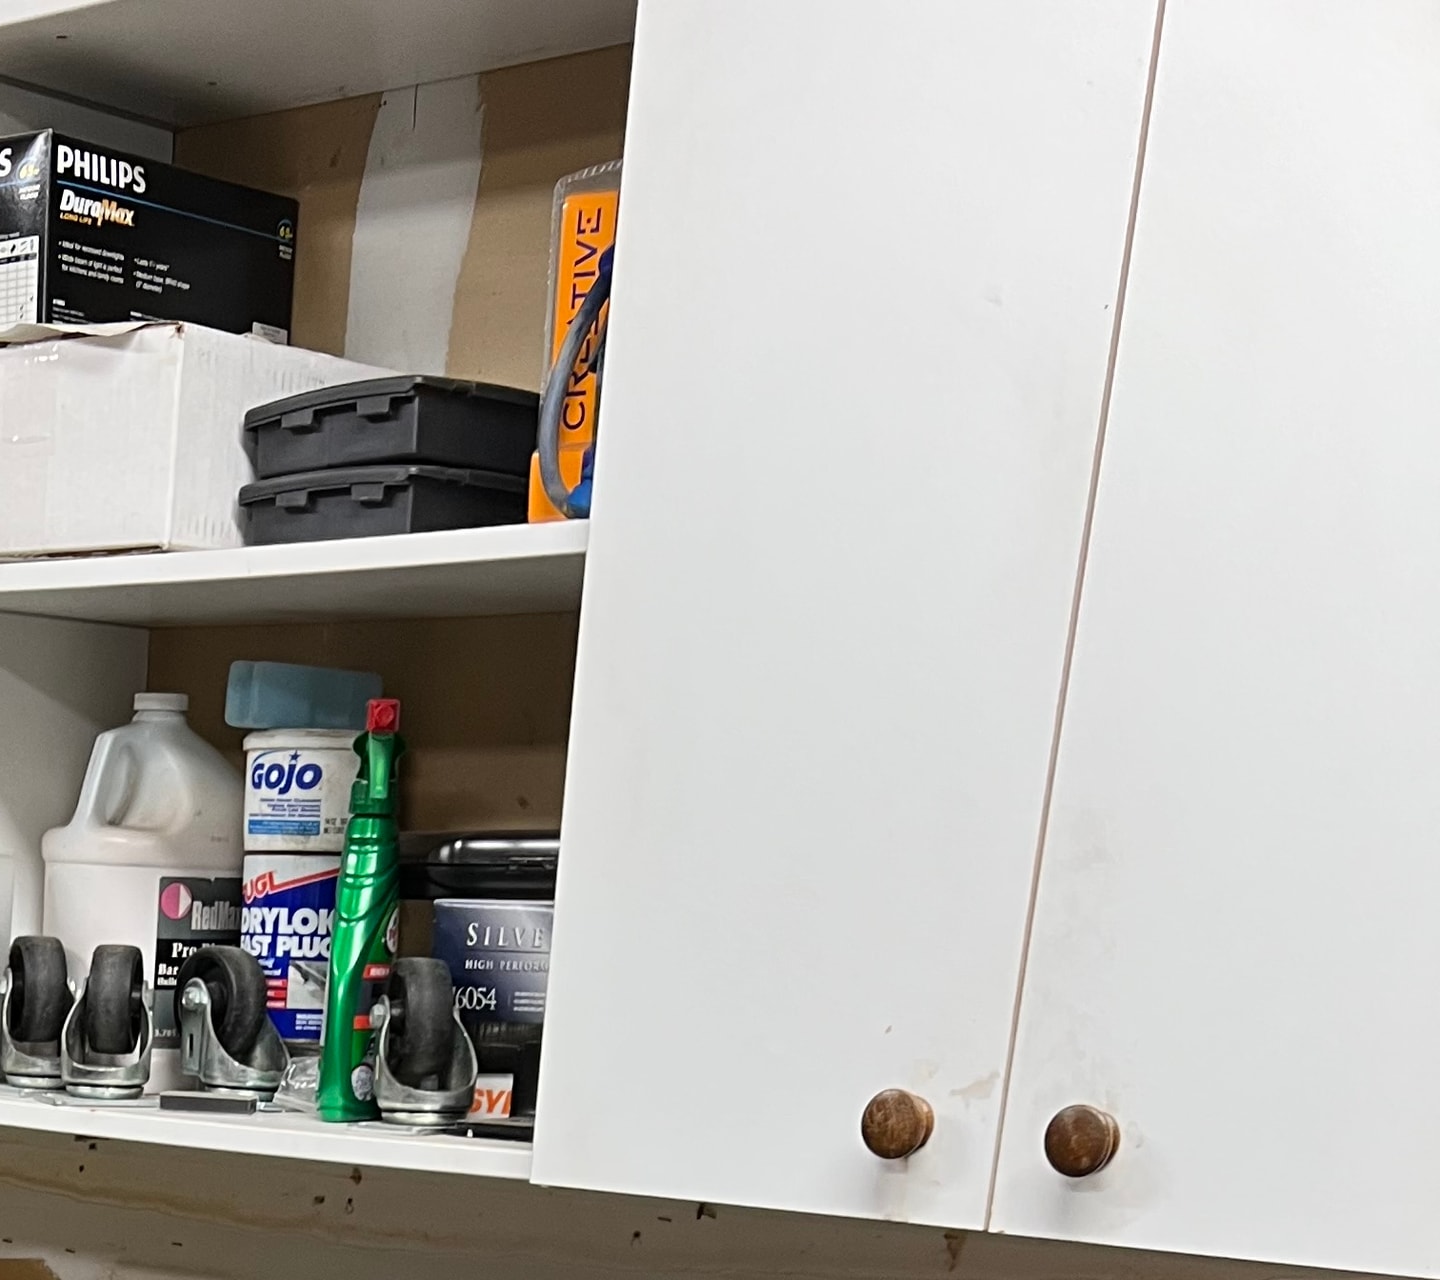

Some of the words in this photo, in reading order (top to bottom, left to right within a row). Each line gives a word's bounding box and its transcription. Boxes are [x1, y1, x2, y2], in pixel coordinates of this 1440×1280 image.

[57, 145, 146, 193] PHILIPS
[60, 189, 135, 226] DuraMax
[251, 762, 323, 795] GOJO
[465, 959, 494, 970] HIGH
[452, 986, 497, 1011] 6054
